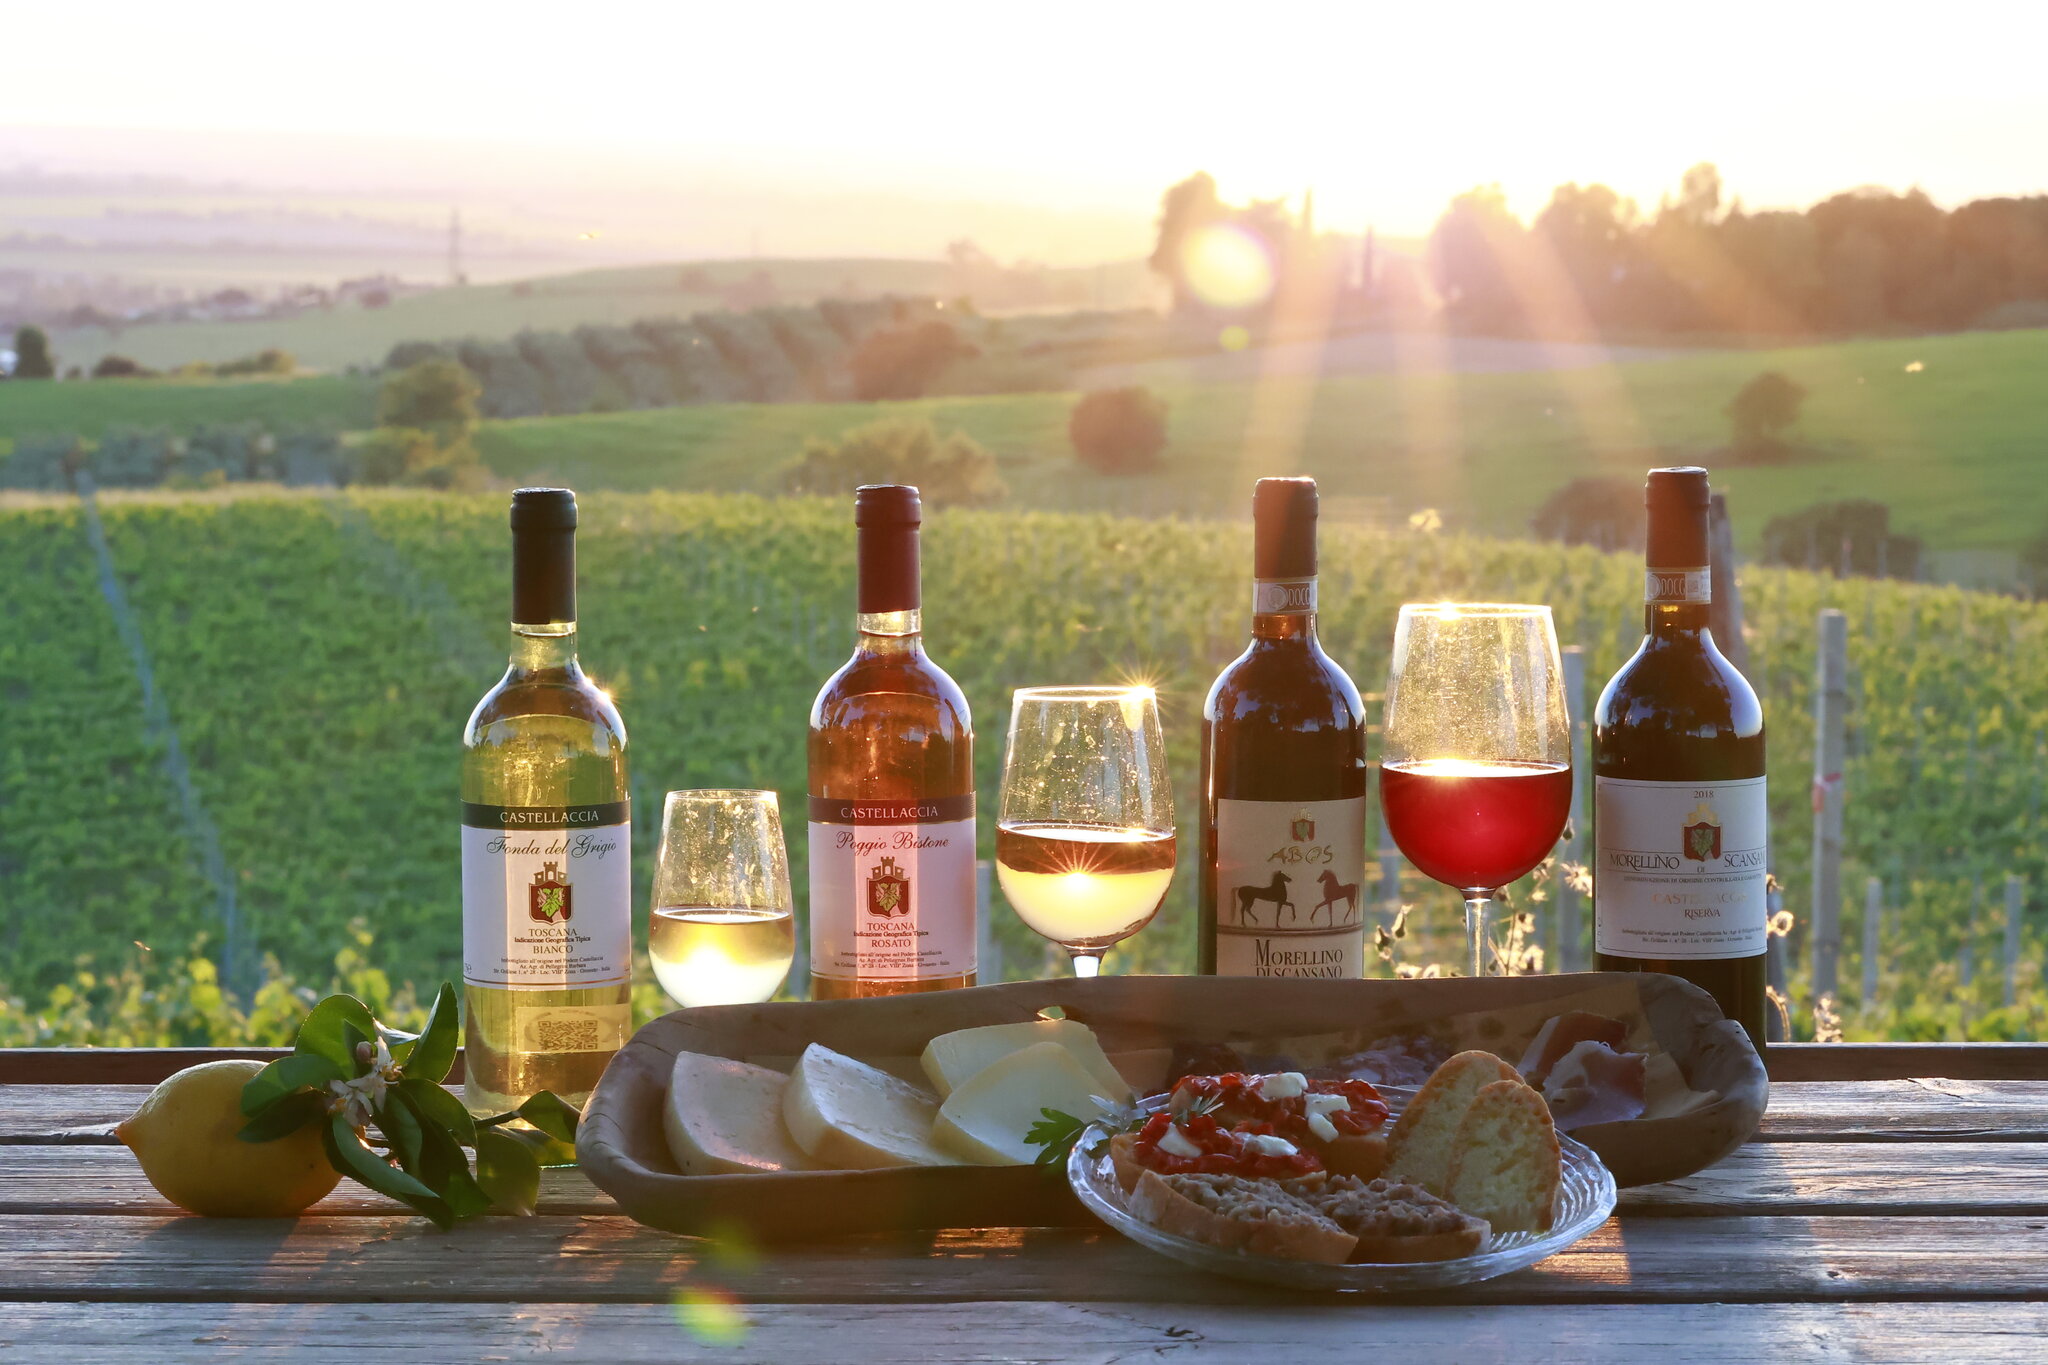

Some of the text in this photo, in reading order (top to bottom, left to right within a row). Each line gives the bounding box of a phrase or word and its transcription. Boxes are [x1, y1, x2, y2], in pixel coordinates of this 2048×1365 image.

[1693, 790, 1714, 799] 2018
[500, 810, 599, 823] CASTELLACCIA
[841, 806, 939, 819] CASTELLACCIA
[486, 834, 617, 860] Fonda del Grigio
[835, 831, 950, 857] Poggio Bistone
[1610, 853, 1680, 871] MORELLINO
[1684, 908, 1721, 920] RISERVA
[528, 928, 578, 937] TOSCANA
[867, 922, 915, 931] TOSCANA
[545, 936, 574, 944] Geografica
[575, 934, 591, 943] Tipica
[871, 939, 911, 948] ROSATO
[533, 944, 574, 954] BIANCO
[1255, 938, 1343, 967] MORELLINO
